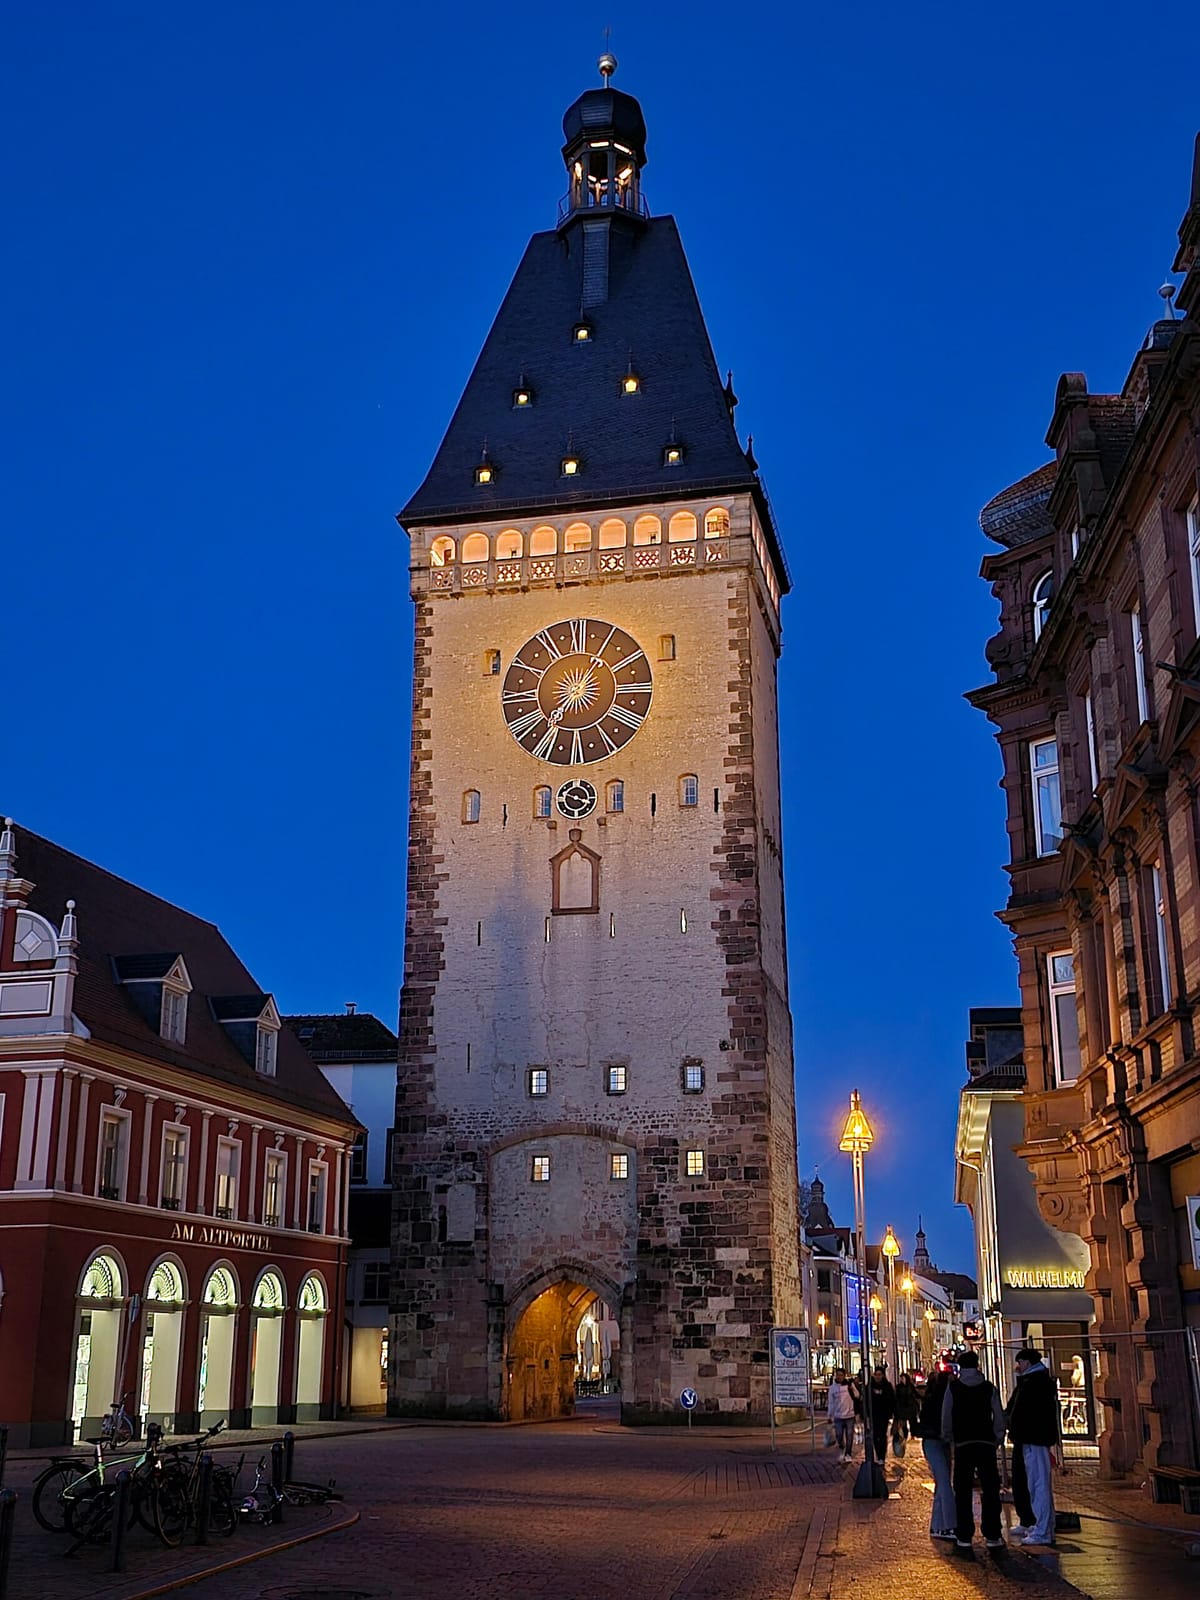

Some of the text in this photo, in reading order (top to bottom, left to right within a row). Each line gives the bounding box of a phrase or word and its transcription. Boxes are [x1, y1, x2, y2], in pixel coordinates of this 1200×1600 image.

[569, 619, 587, 654] XII
[512, 657, 544, 679] X
[611, 648, 644, 673] II
[616, 682, 652, 694] III
[170, 1222, 273, 1252] AM ALTPORTEL
[1007, 1269, 1086, 1289] WILHELMI
